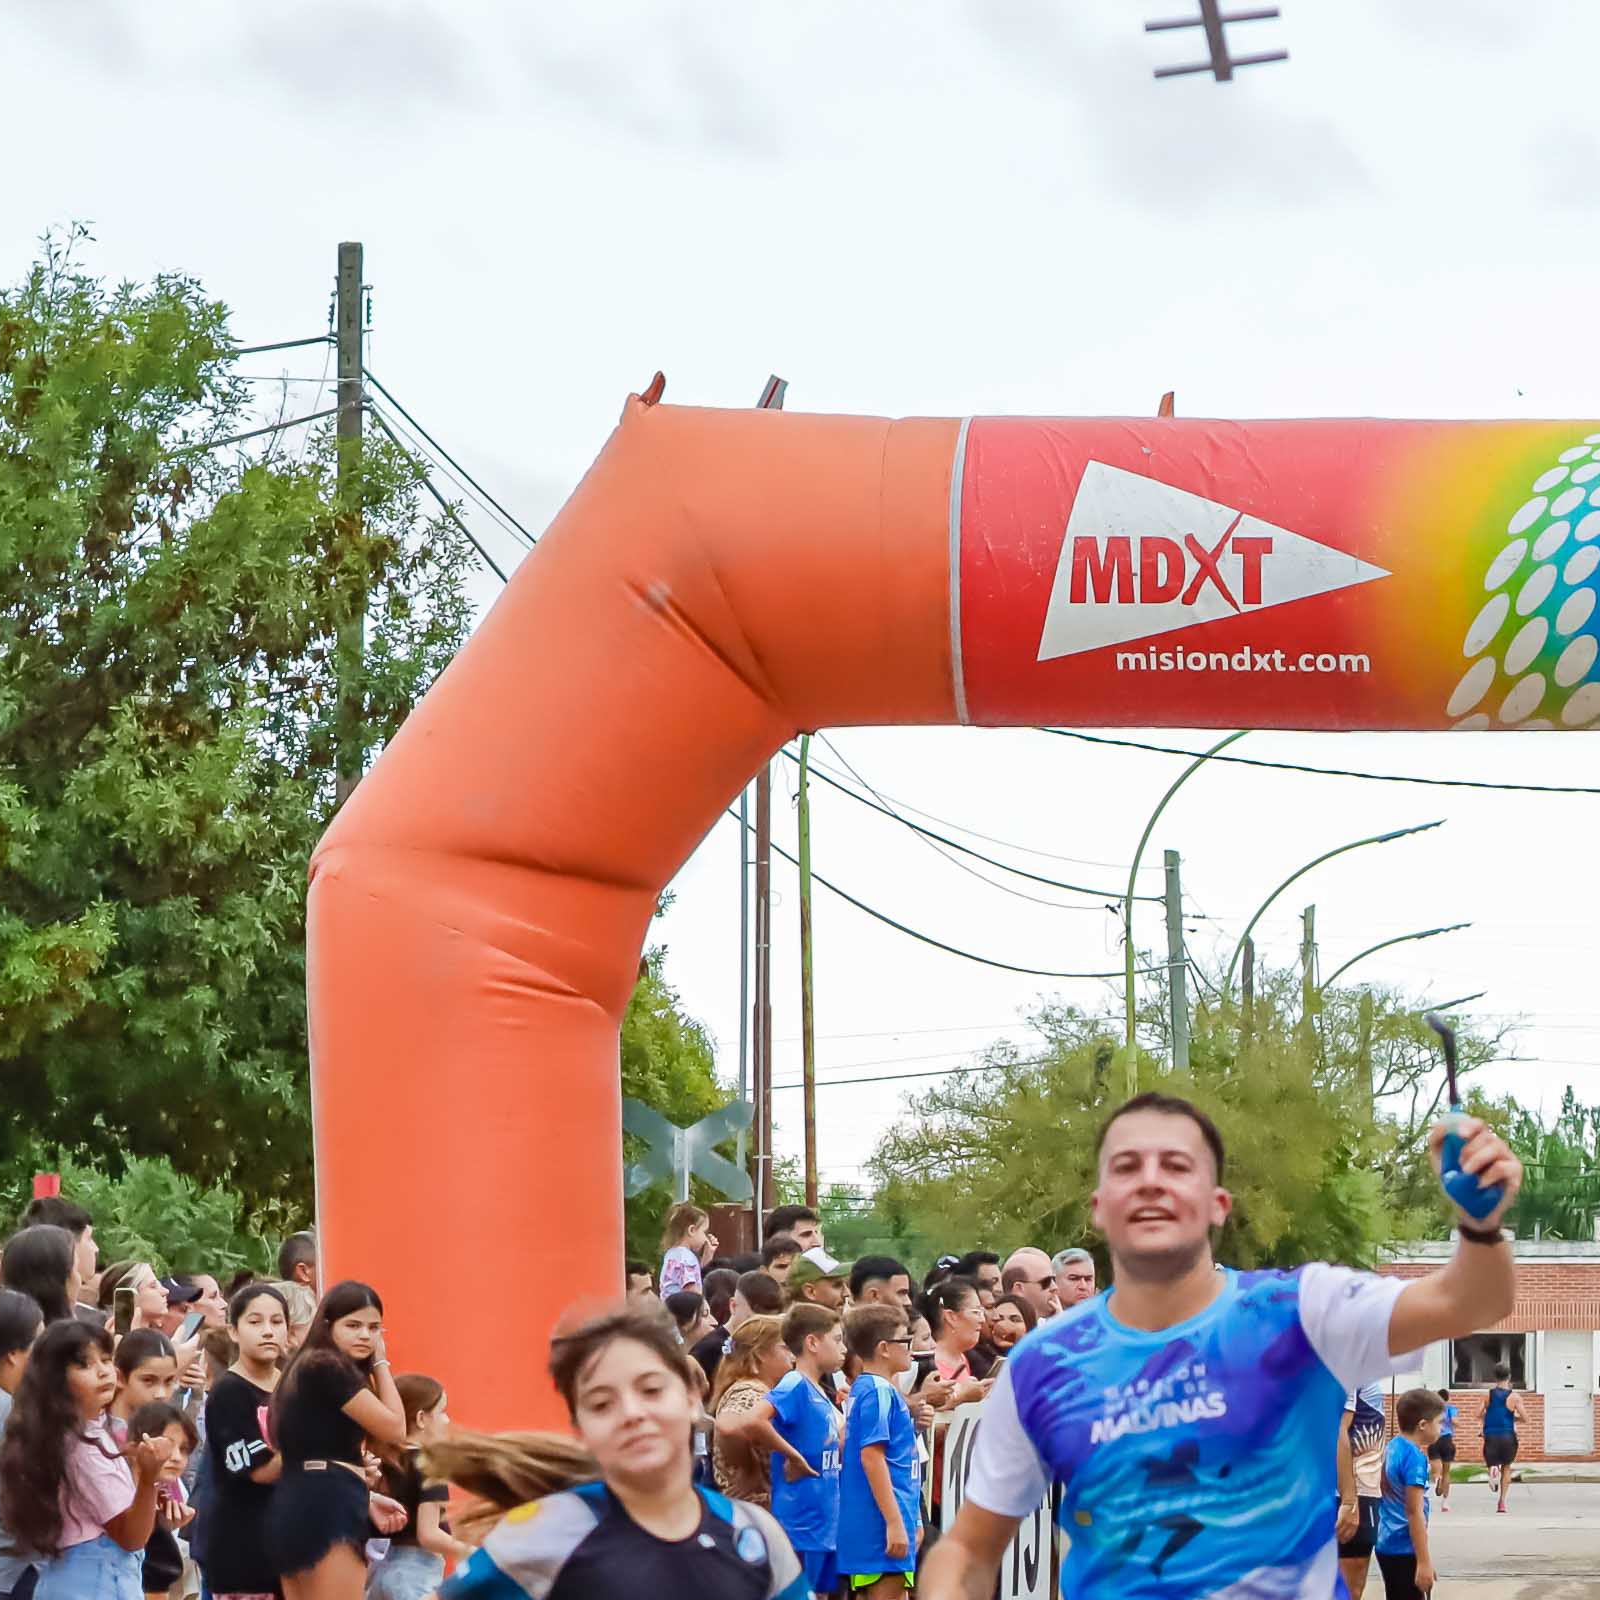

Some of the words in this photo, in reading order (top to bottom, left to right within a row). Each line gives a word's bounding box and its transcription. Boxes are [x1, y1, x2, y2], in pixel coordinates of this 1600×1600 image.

[1069, 511, 1274, 613] MDXT
[1115, 645, 1371, 673] misiondxt.com
[1090, 1391, 1228, 1444] MALVINAS
